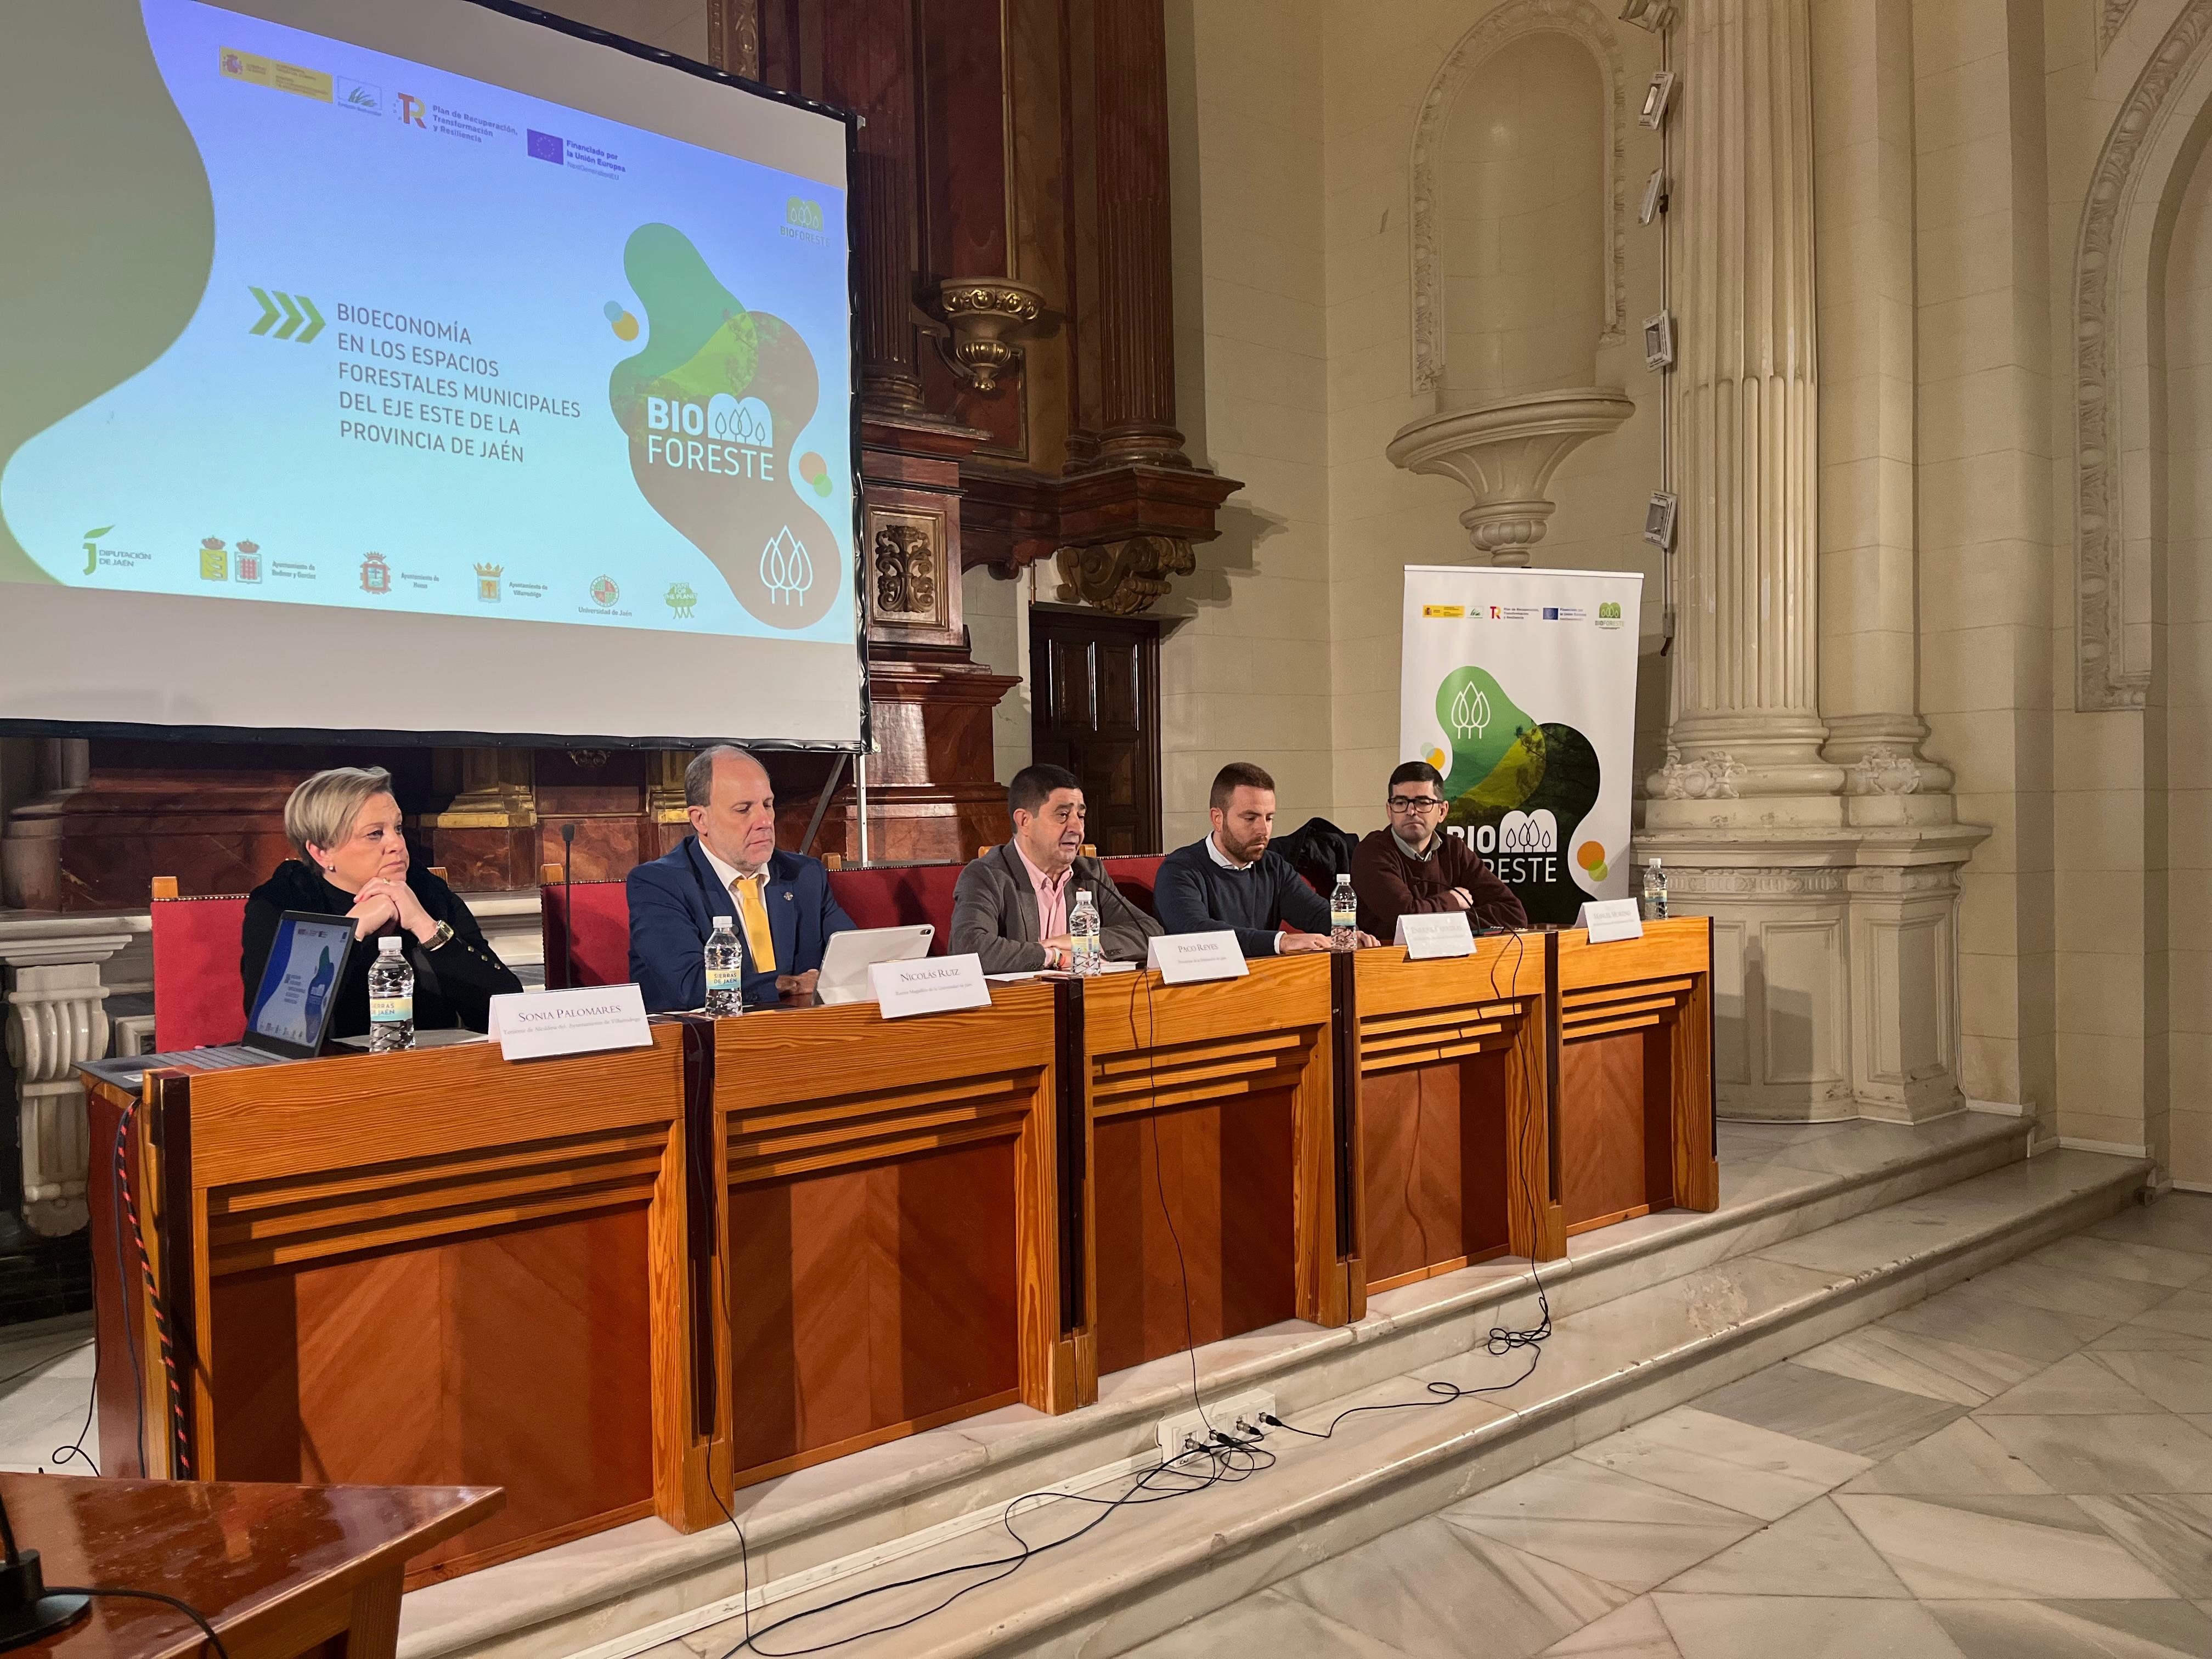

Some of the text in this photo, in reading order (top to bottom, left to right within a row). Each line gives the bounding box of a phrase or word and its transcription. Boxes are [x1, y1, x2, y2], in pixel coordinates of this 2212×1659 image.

[433, 105, 518, 136] Plan de Recuperación,
[433, 114, 493, 137] Transformación
[441, 125, 482, 143] Resiliencia
[567, 139, 605, 157] Financiado
[567, 149, 626, 172] la Unión Europea
[780, 225, 831, 247] BIOFORESTE
[337, 302, 472, 345] BIOECONOMÍA
[338, 332, 499, 377] EN LOS ESPACIOS
[338, 362, 580, 418] FORESTALES MUNICIPALES
[340, 391, 521, 436] DEL EJE ESTE DE LA
[647, 396, 704, 436] BIO
[340, 420, 524, 463] PROVINCIA DE JAÉN
[648, 434, 774, 482] FORESTE
[99, 550, 151, 560] DIPUTACIÓN
[578, 606, 611, 615] Universidad
[900, 968, 961, 982] NICOLÁS RUIZ
[518, 1005, 622, 1023] SONIA PALOMARES
